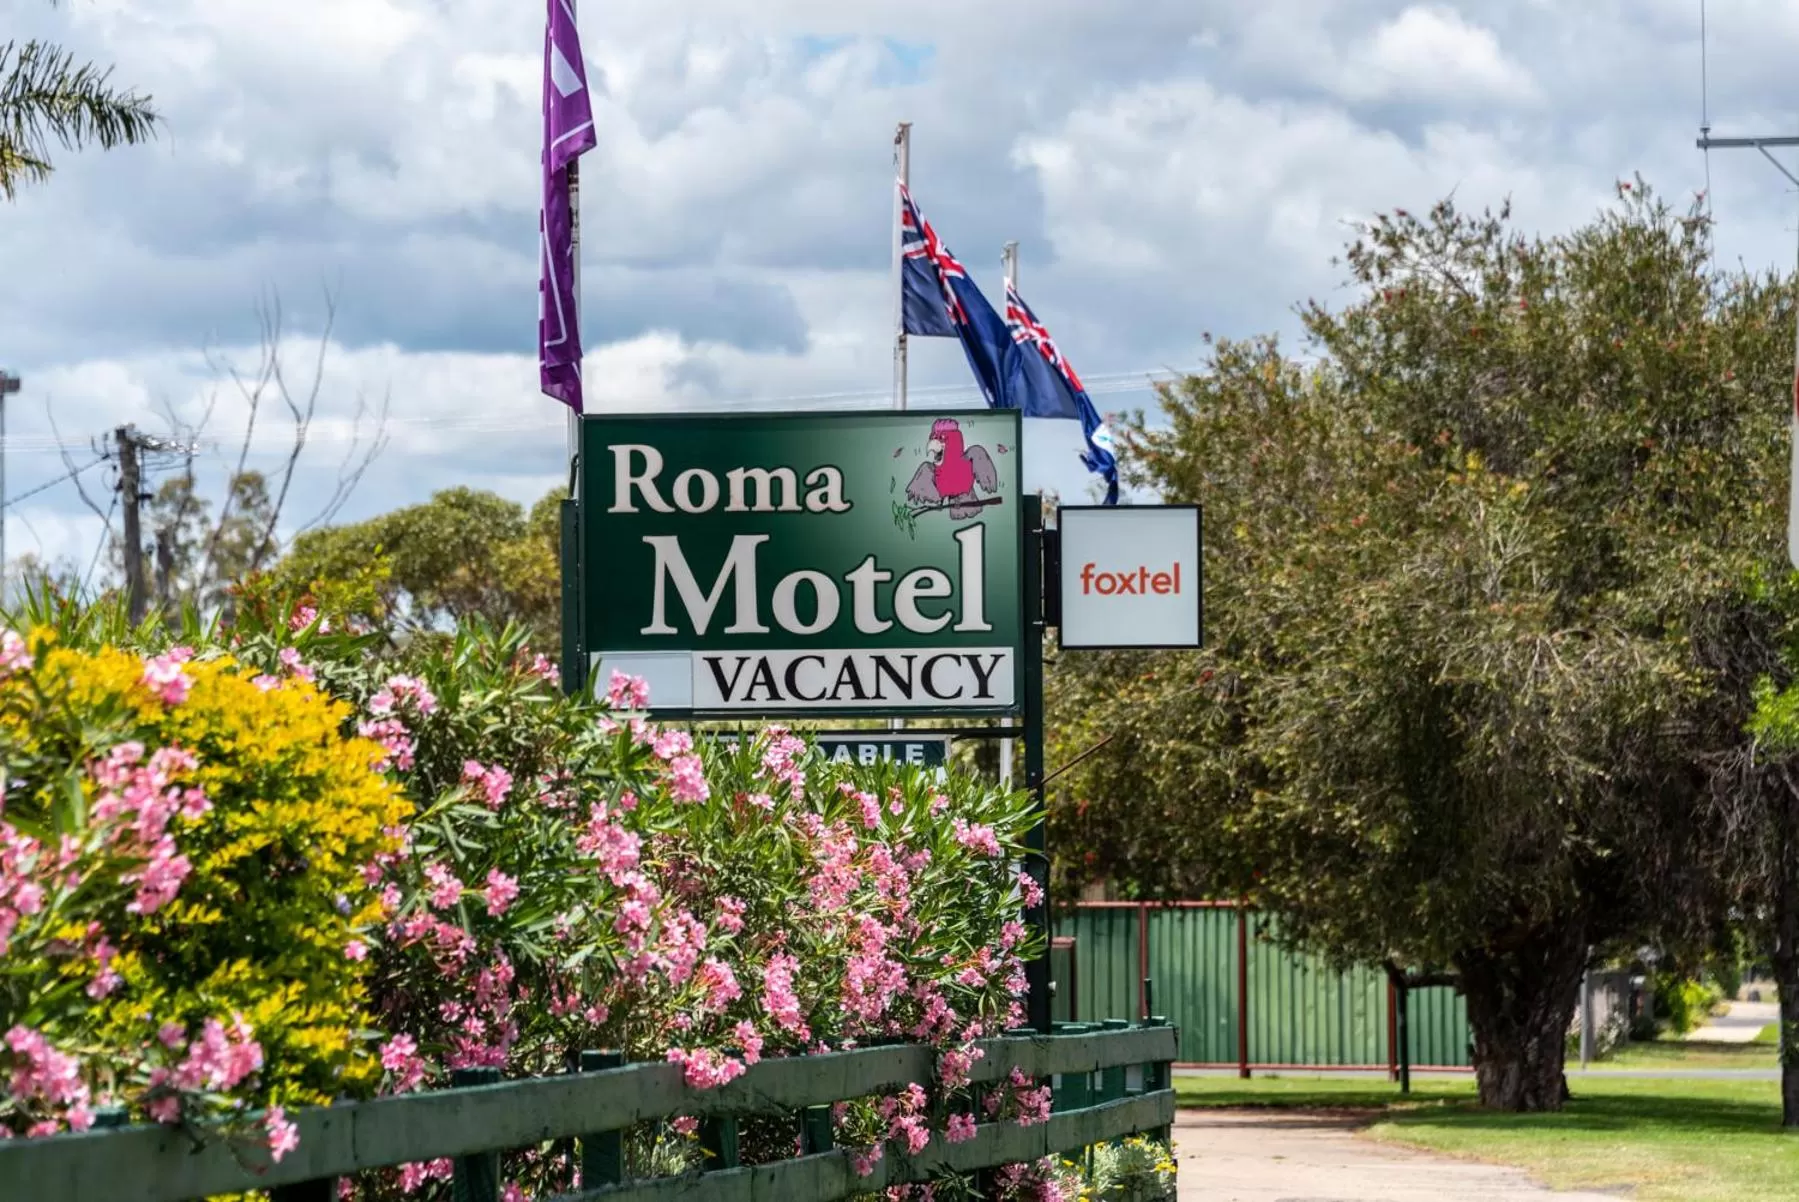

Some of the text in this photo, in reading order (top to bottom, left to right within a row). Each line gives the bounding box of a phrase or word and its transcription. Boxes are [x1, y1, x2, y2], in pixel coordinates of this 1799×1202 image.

[607, 443, 851, 514] Roma
[641, 522, 994, 636] Motel
[1080, 562, 1180, 595] foxtel
[703, 654, 1006, 702] VACANCY
